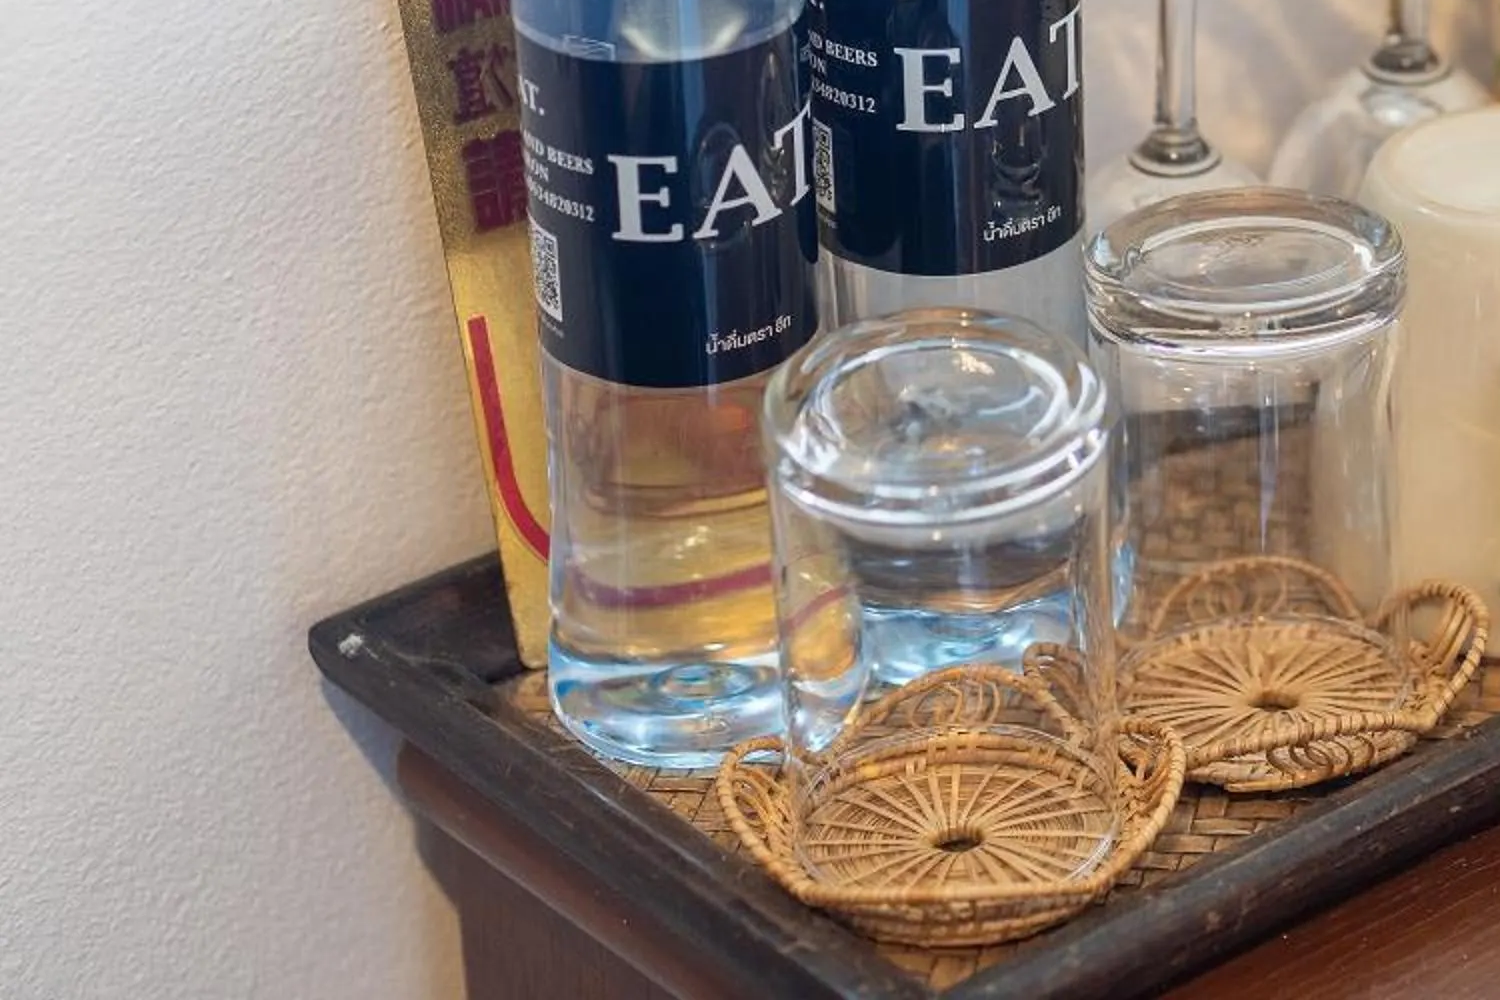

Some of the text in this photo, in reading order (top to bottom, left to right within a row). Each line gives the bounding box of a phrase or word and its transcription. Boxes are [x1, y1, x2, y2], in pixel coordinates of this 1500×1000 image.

[825, 39, 879, 68] BEERS
[893, 1, 1081, 133] EAT
[547, 145, 594, 176] BEERS
[607, 98, 811, 243] EAT
